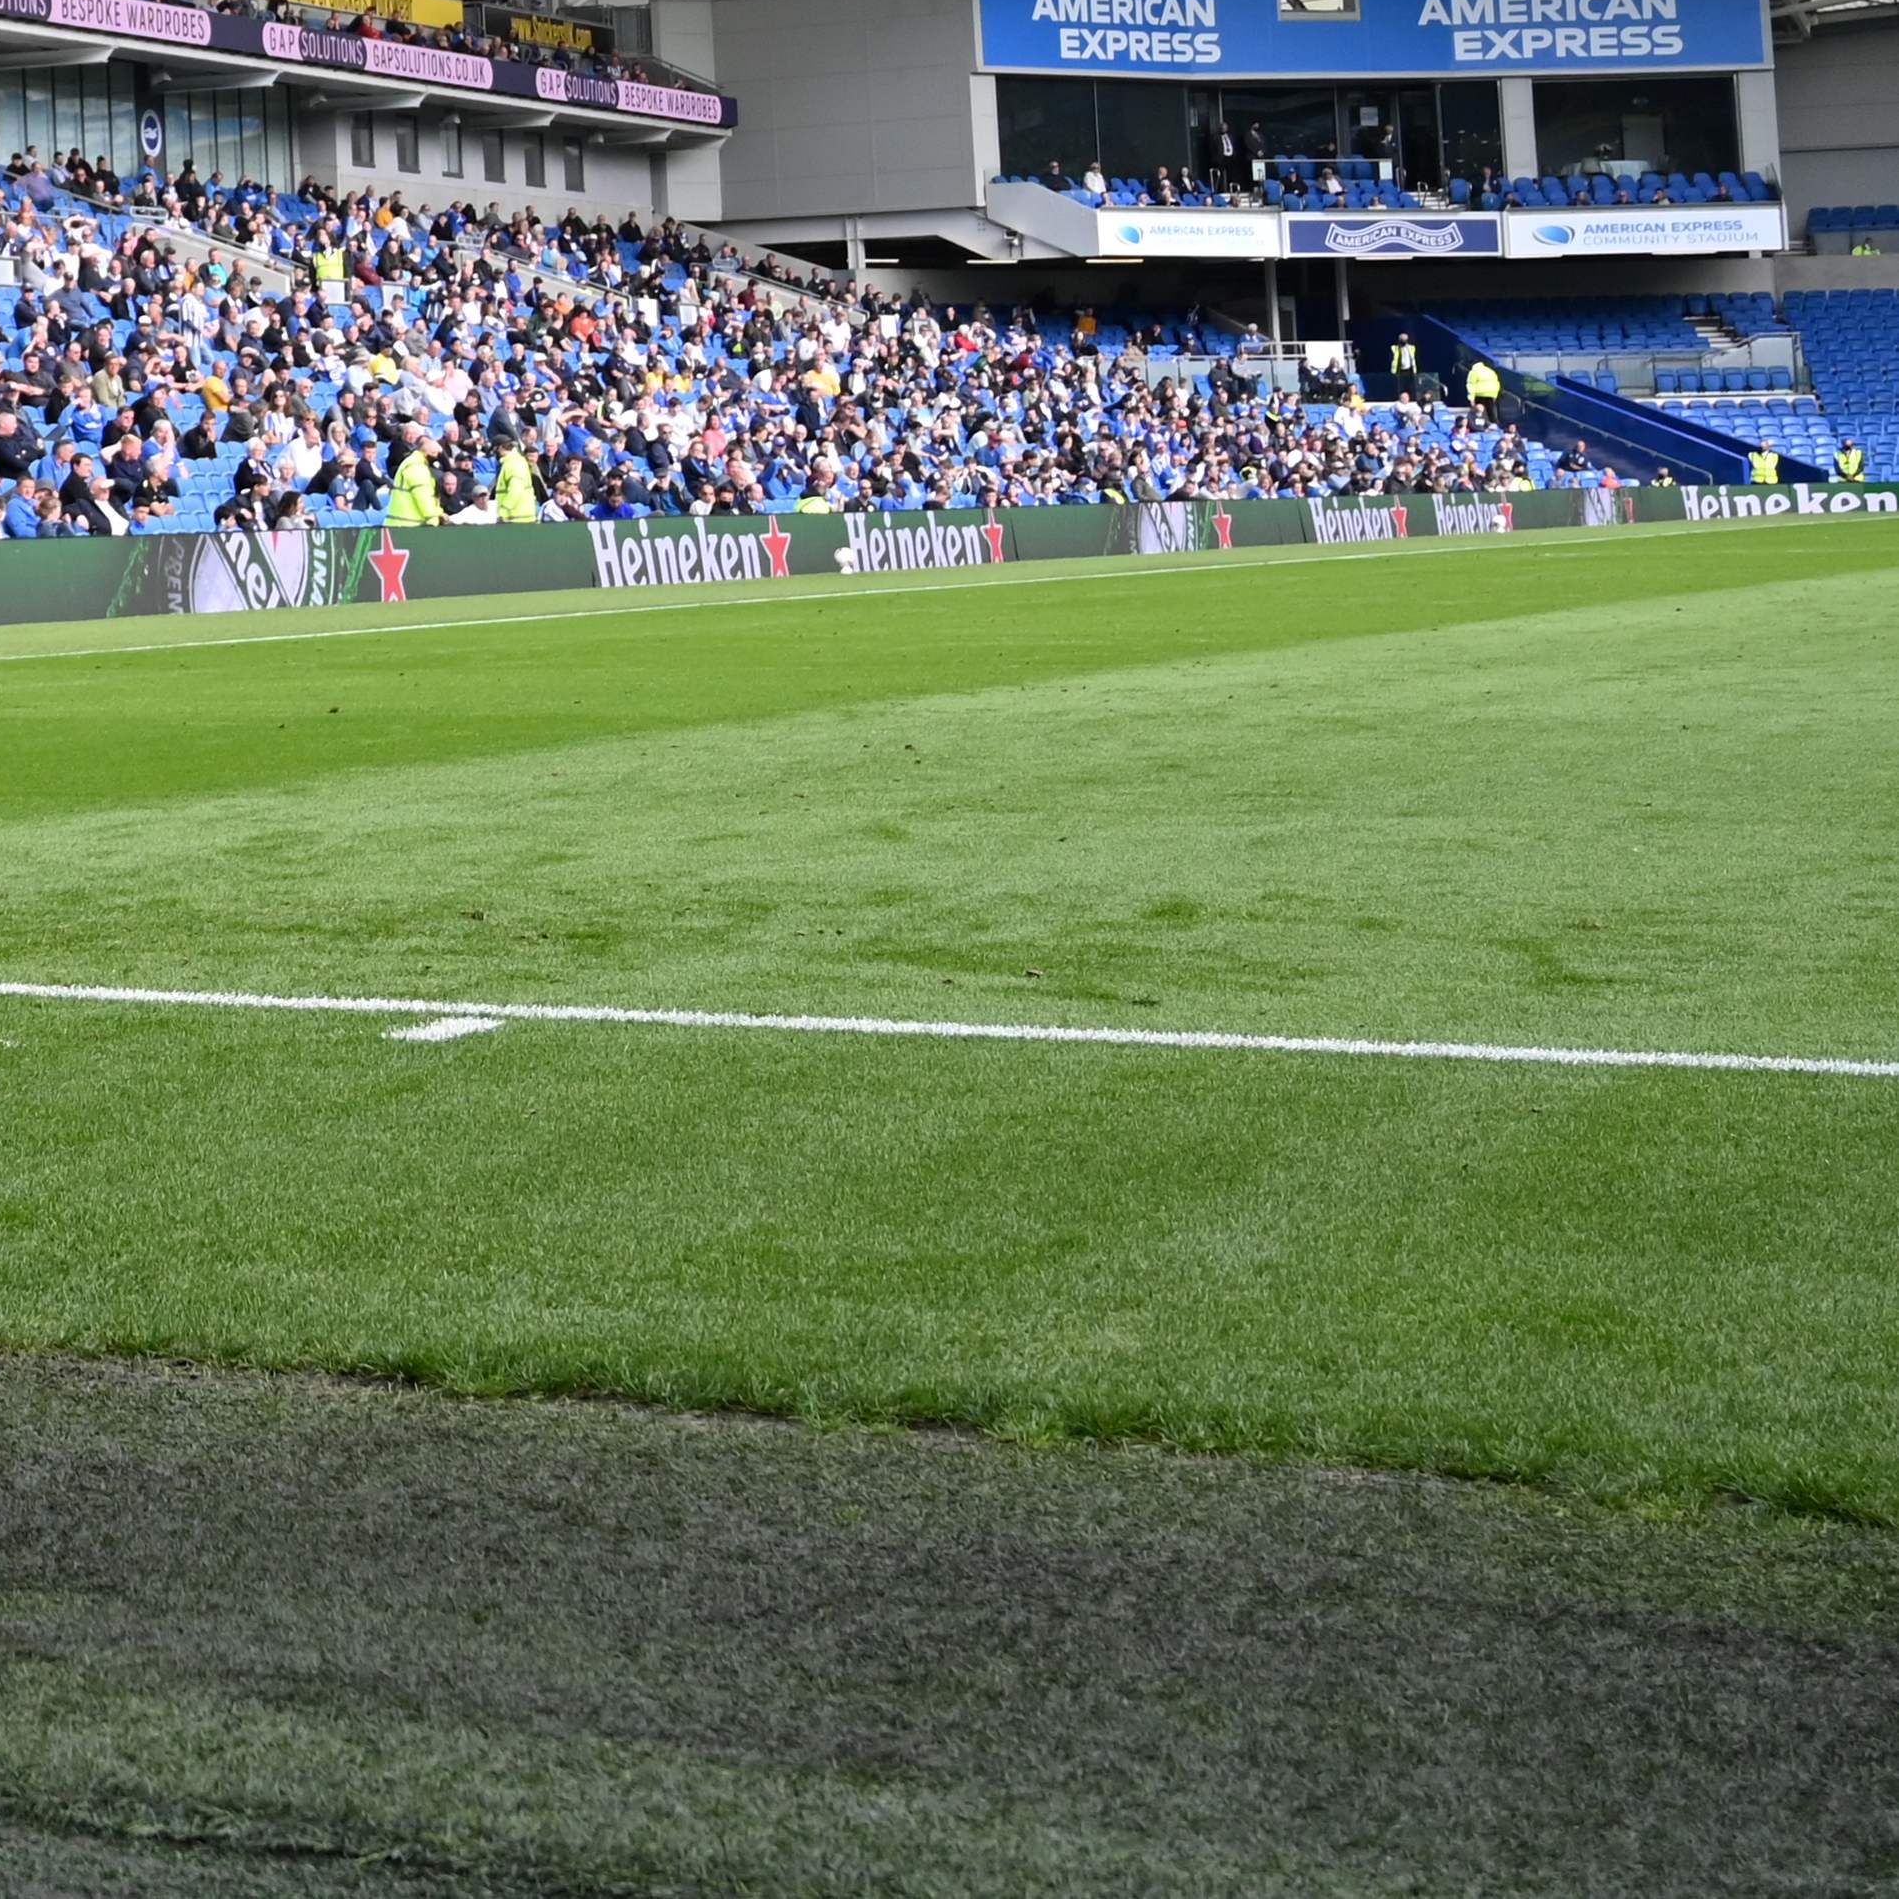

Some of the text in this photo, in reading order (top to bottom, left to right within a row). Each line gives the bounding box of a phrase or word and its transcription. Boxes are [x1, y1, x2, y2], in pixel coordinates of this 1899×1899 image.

[126, 2, 206, 40] WARDROBES
[269, 28, 487, 84] GAP SOLUTIONS GAPSOLUTIONS.CO.UK
[1059, 27, 1222, 64] EXPRESS
[1453, 24, 1684, 62] EXPRESS
[540, 71, 718, 120] GAP SOLUTIONS BESPOKE WARDROBES
[1149, 225, 1256, 237] AMERICAN EXPRESS
[1334, 226, 1453, 248] AMERICAN EXPRESS
[1582, 232, 1759, 247] COMMUNITY STADIUM
[1583, 220, 1743, 234] AMERICAN EXPRESS
[1307, 495, 1395, 544] Heineken
[1431, 491, 1499, 537] Heineken
[1681, 483, 1898, 521] Heineken
[588, 516, 763, 589] Heineken
[843, 510, 983, 573] Heineken
